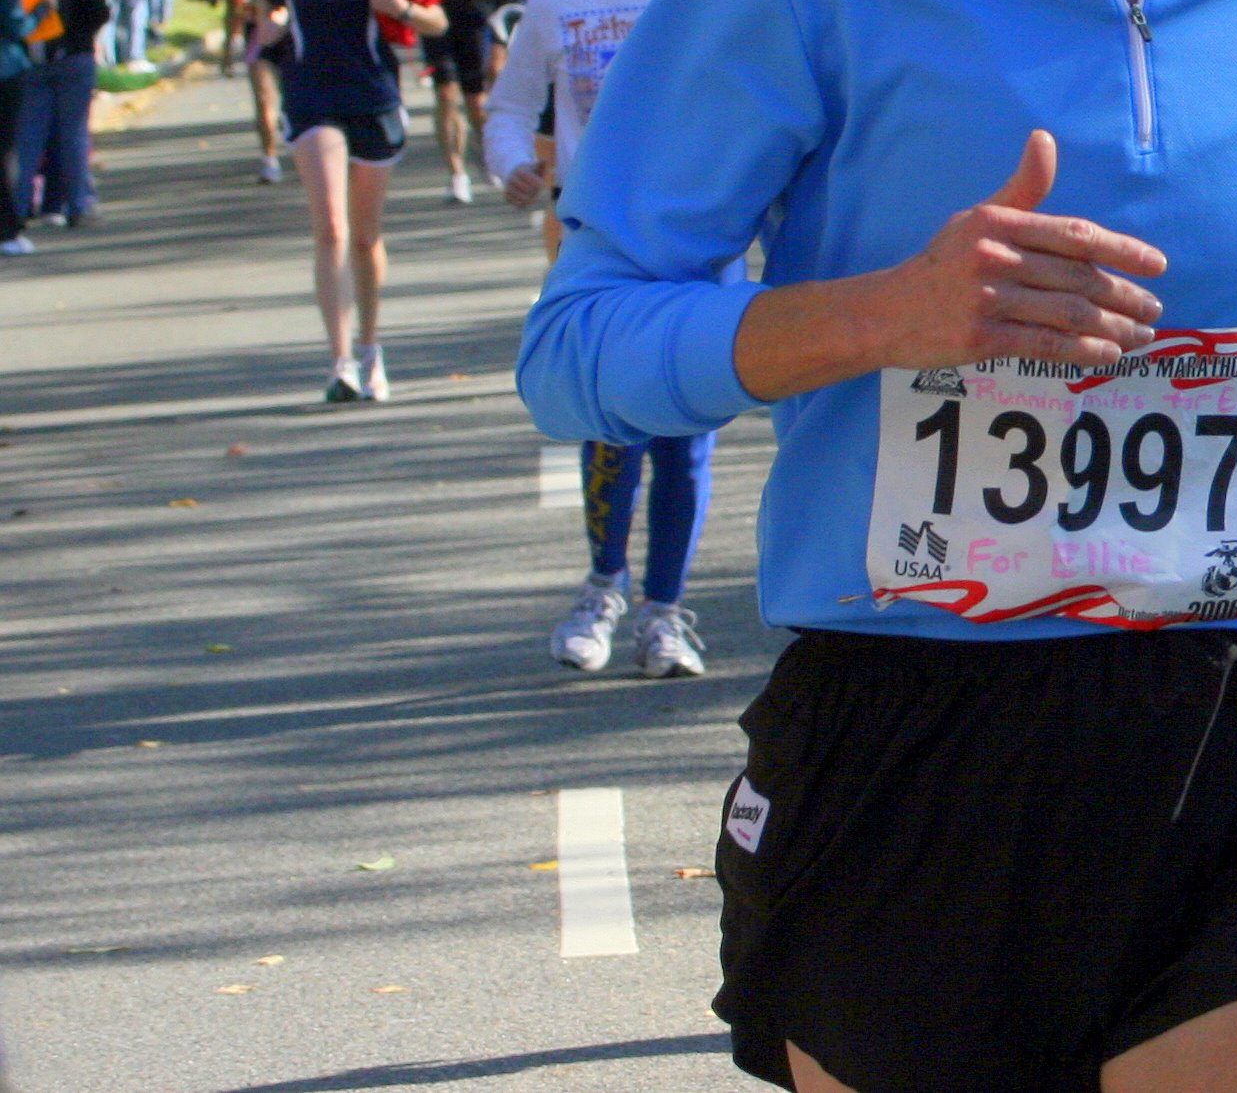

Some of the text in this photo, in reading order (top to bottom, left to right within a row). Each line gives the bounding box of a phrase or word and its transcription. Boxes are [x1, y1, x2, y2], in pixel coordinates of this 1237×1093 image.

[1018, 358, 1087, 379] MARIN
[966, 537, 1153, 579] For Ellie
[894, 559, 944, 581] USAA
